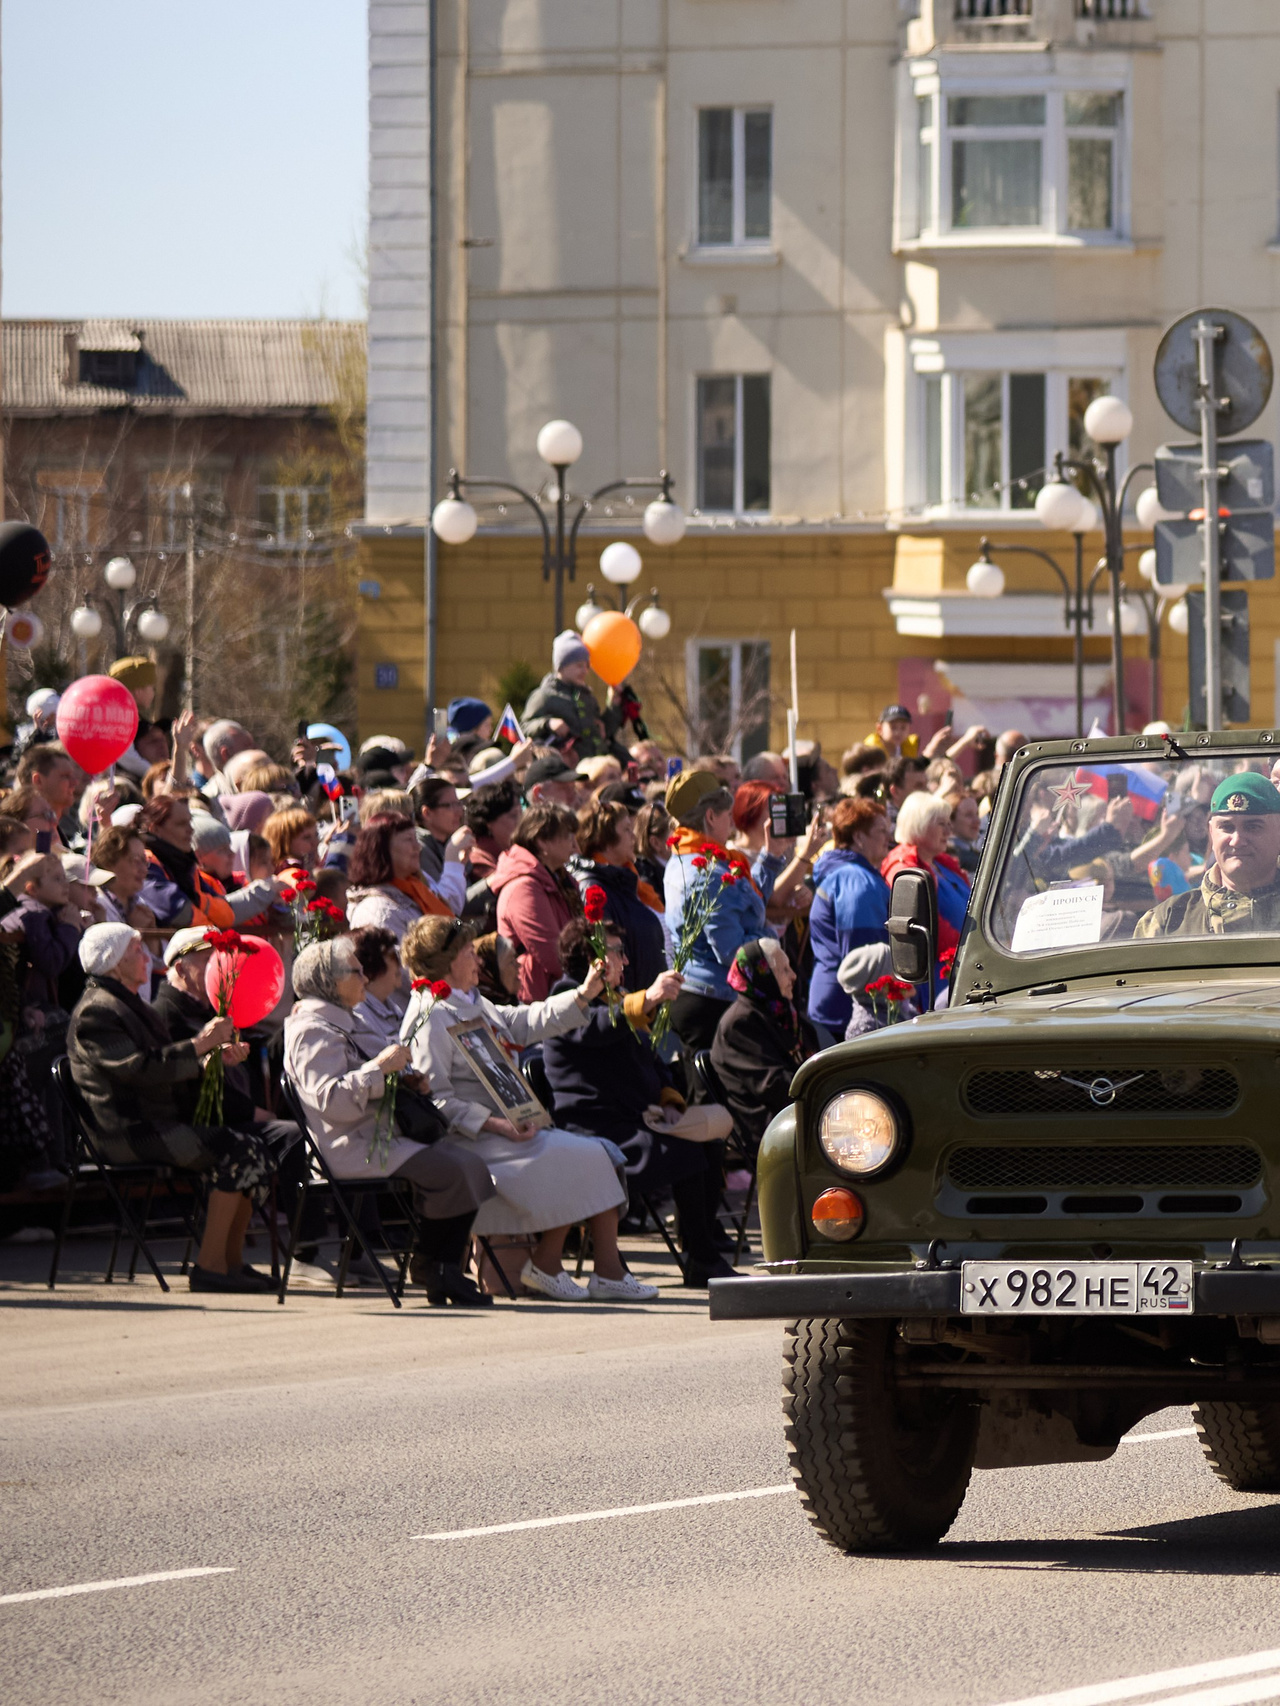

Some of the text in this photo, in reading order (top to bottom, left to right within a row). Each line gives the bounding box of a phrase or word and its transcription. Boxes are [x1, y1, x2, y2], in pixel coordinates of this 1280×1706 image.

[1052, 894, 1098, 906] ПРОПУСК
[1143, 1266, 1179, 1296] 42
[1140, 1298, 1167, 1308] RUS
